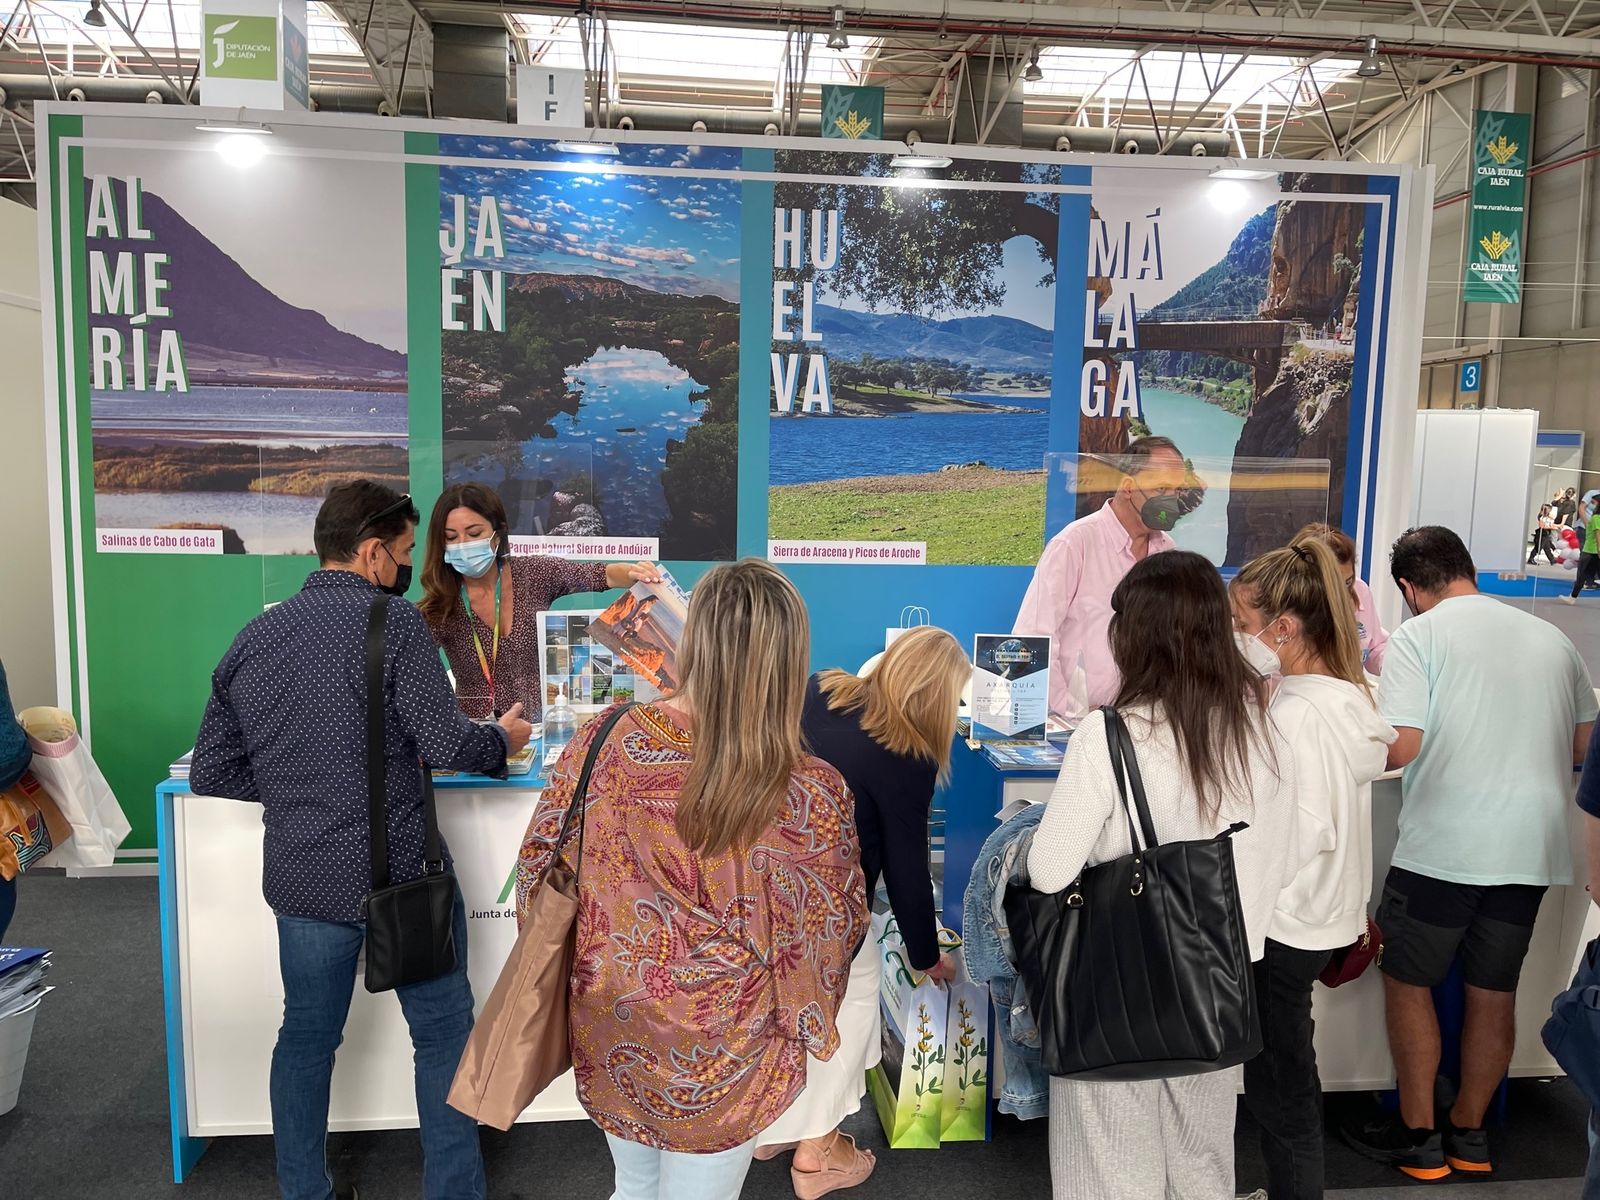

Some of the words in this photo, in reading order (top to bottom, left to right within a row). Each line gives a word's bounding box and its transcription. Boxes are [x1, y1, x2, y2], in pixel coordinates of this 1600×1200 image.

[226, 43, 270, 52] DIPUTACIÓN
[1497, 168, 1524, 177] RURAL
[87, 174, 152, 239] AL
[439, 194, 505, 258] JA
[1473, 204, 1523, 212] www.ruralvia.com
[774, 207, 839, 270] HU
[1088, 207, 1162, 280] MÁ
[1491, 264, 1517, 272] RURAL
[90, 250, 170, 317] ME
[773, 281, 823, 341] EL
[1084, 290, 1137, 349] LA
[92, 312, 188, 393] RÍA
[1465, 366, 1477, 388] 3
[770, 352, 831, 413] VA
[1080, 359, 1140, 418] GA
[102, 534, 138, 546] Salinas
[140, 535, 152, 547] de
[154, 535, 177, 547] Cabo
[180, 536, 193, 547] de
[194, 536, 215, 548] Gata
[509, 542, 540, 556] Parque
[542, 543, 575, 555] Natural
[577, 543, 603, 555] Sierra
[605, 544, 616, 555] de
[618, 543, 652, 556] Andújar
[773, 546, 799, 557] Sierra
[801, 546, 811, 557] de
[813, 547, 847, 558] Aracena
[849, 548, 854, 559] y
[855, 547, 877, 558] Picos
[879, 547, 890, 558] de
[891, 548, 921, 559] Aroche
[470, 909, 501, 919] Junta
[504, 908, 517, 918] de
